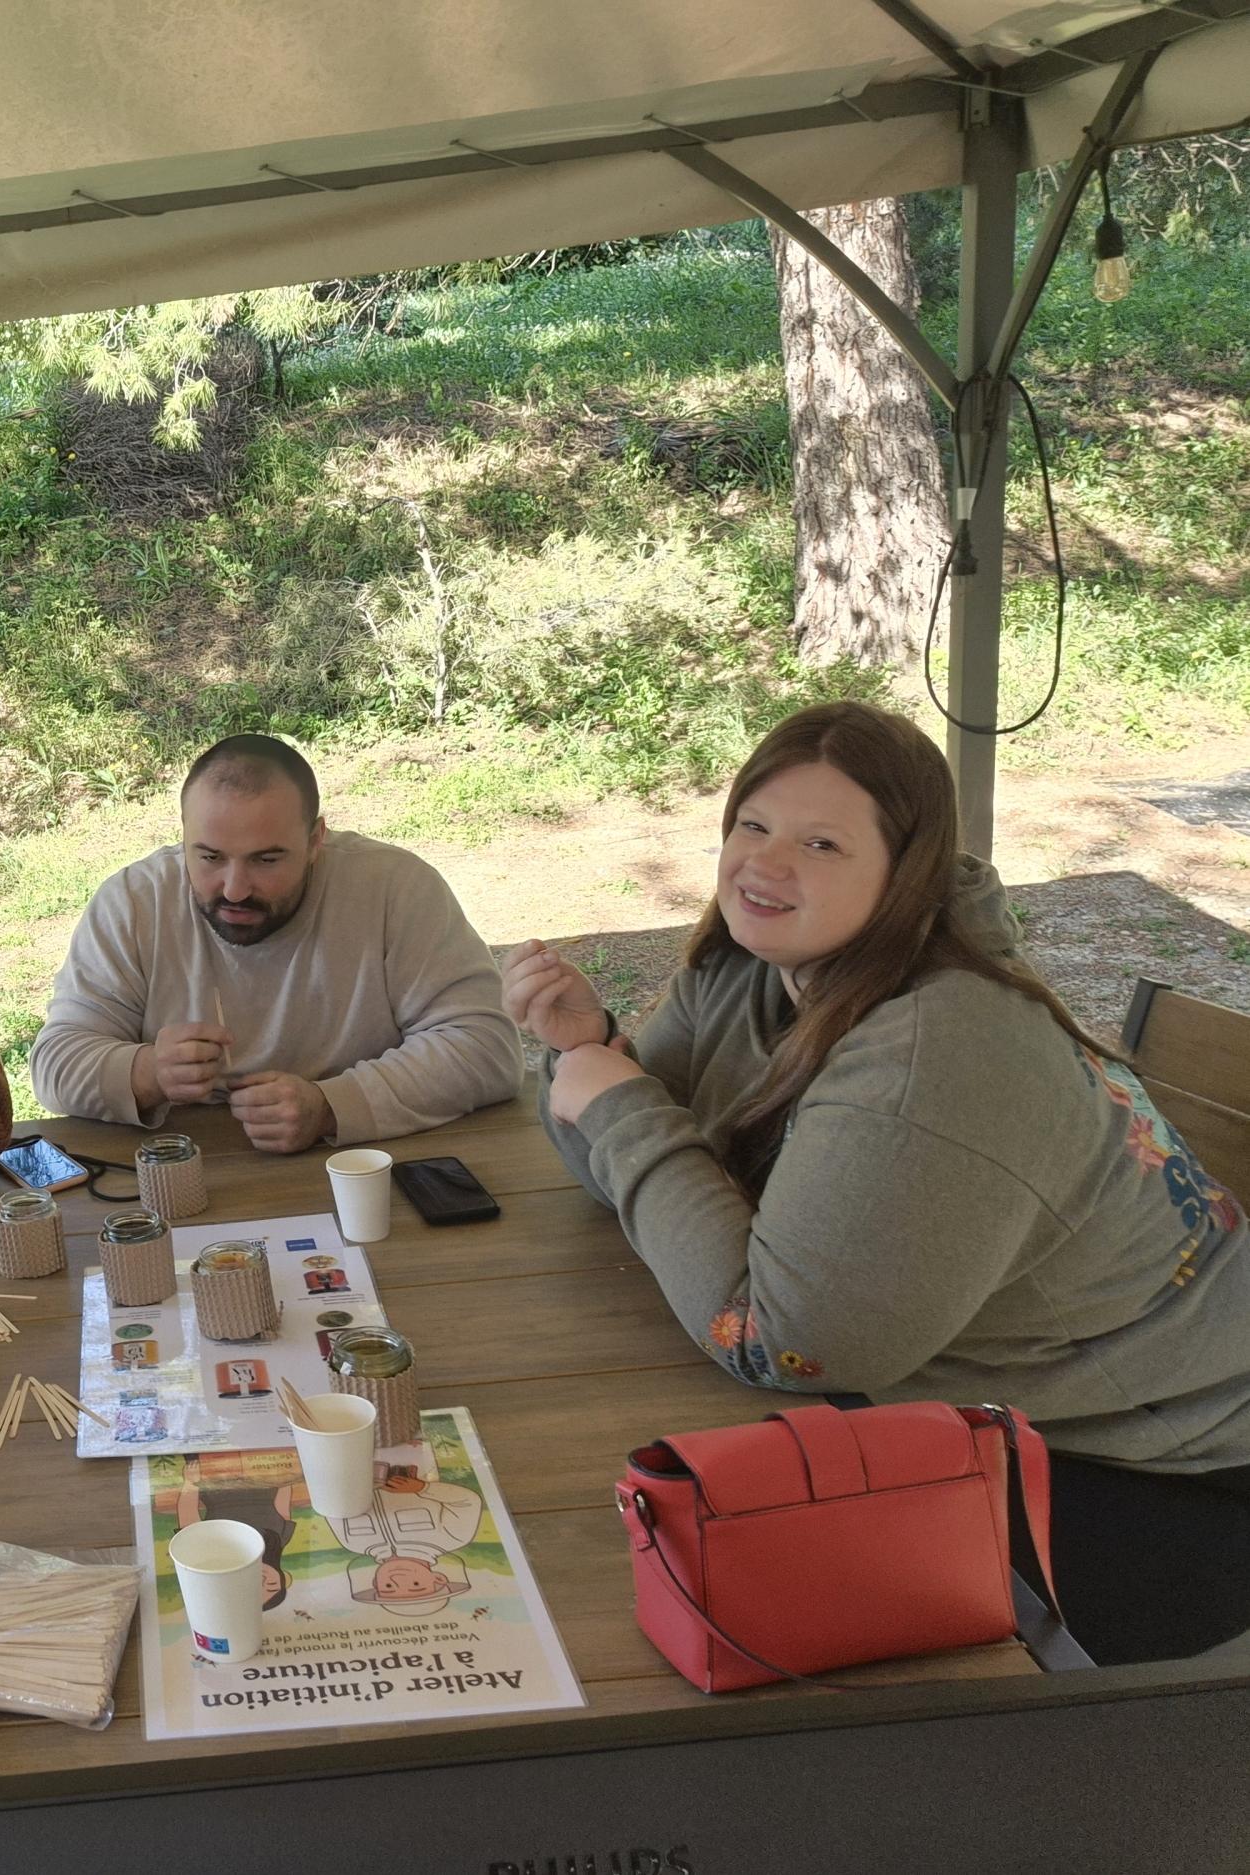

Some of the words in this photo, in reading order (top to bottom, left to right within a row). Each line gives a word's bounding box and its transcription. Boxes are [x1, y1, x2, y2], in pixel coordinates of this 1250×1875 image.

[354, 1628, 372, 1636] au
[374, 1624, 430, 1636] abeilles
[433, 1622, 459, 1631] des
[273, 1634, 292, 1645] de
[298, 1630, 351, 1642] Rucher
[433, 1632, 481, 1642] Venez
[340, 1641, 354, 1651] le
[357, 1635, 429, 1650] découvrir
[284, 1643, 336, 1657] monde
[453, 1650, 475, 1669] à
[406, 1669, 524, 1694] Atelier
